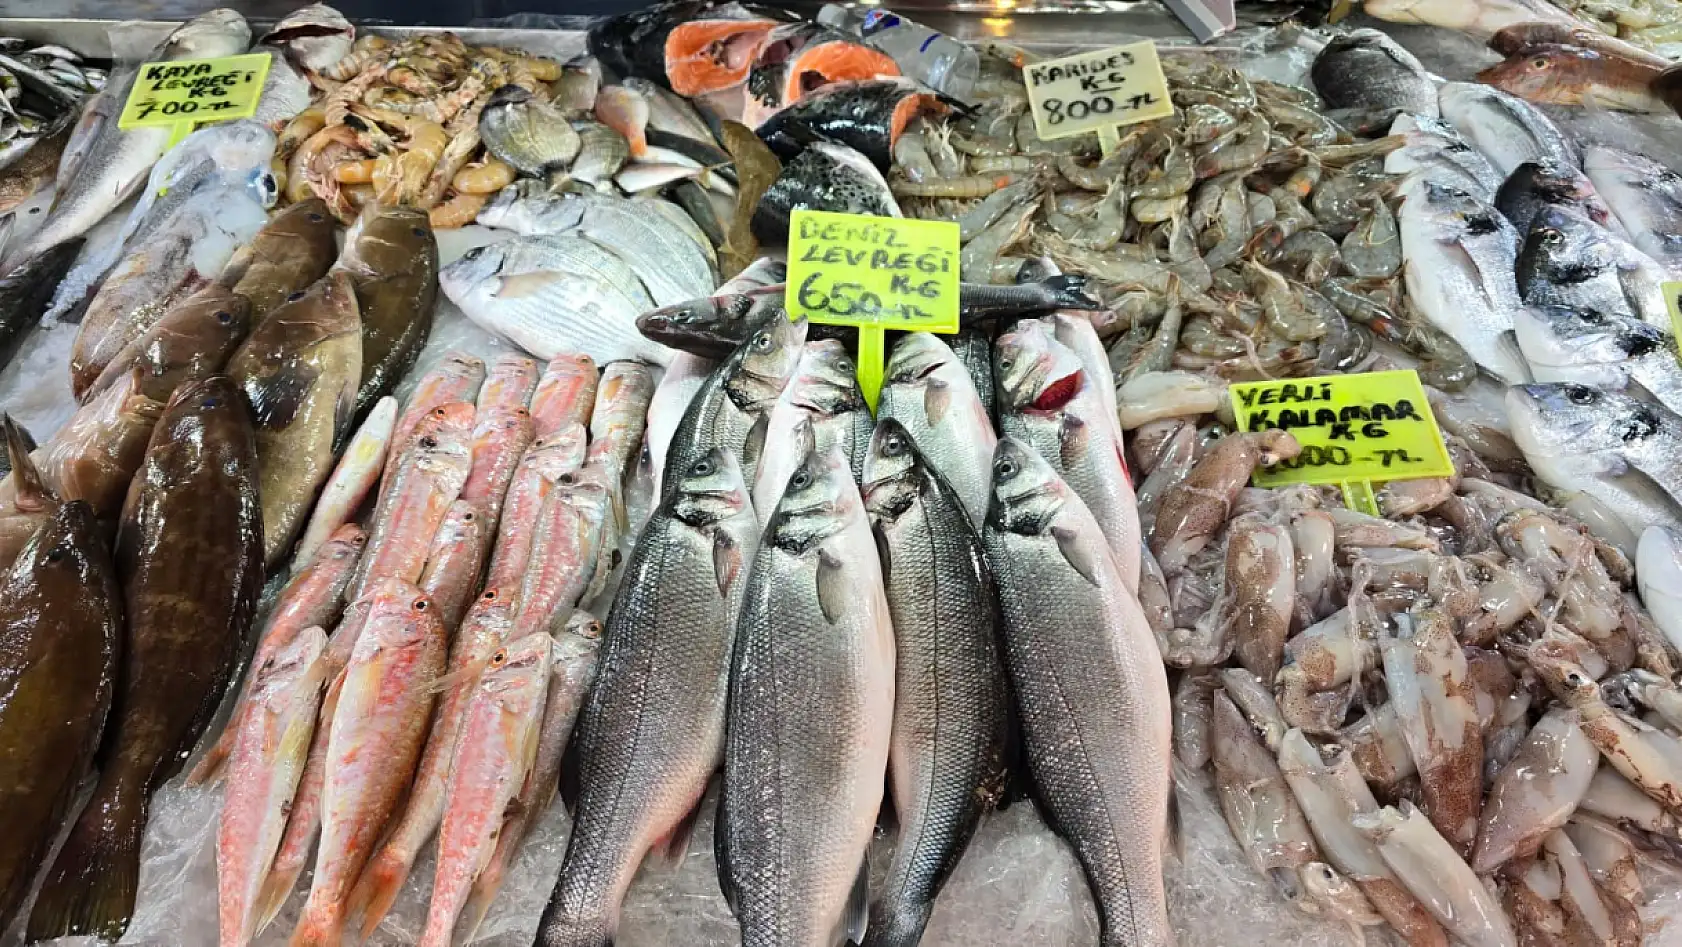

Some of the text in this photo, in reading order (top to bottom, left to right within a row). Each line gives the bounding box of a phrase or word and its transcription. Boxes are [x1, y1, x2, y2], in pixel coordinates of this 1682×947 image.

[146, 63, 212, 80] KAYA
[800, 216, 909, 247] DENİZ
[1248, 399, 1424, 430] KALAMAR
